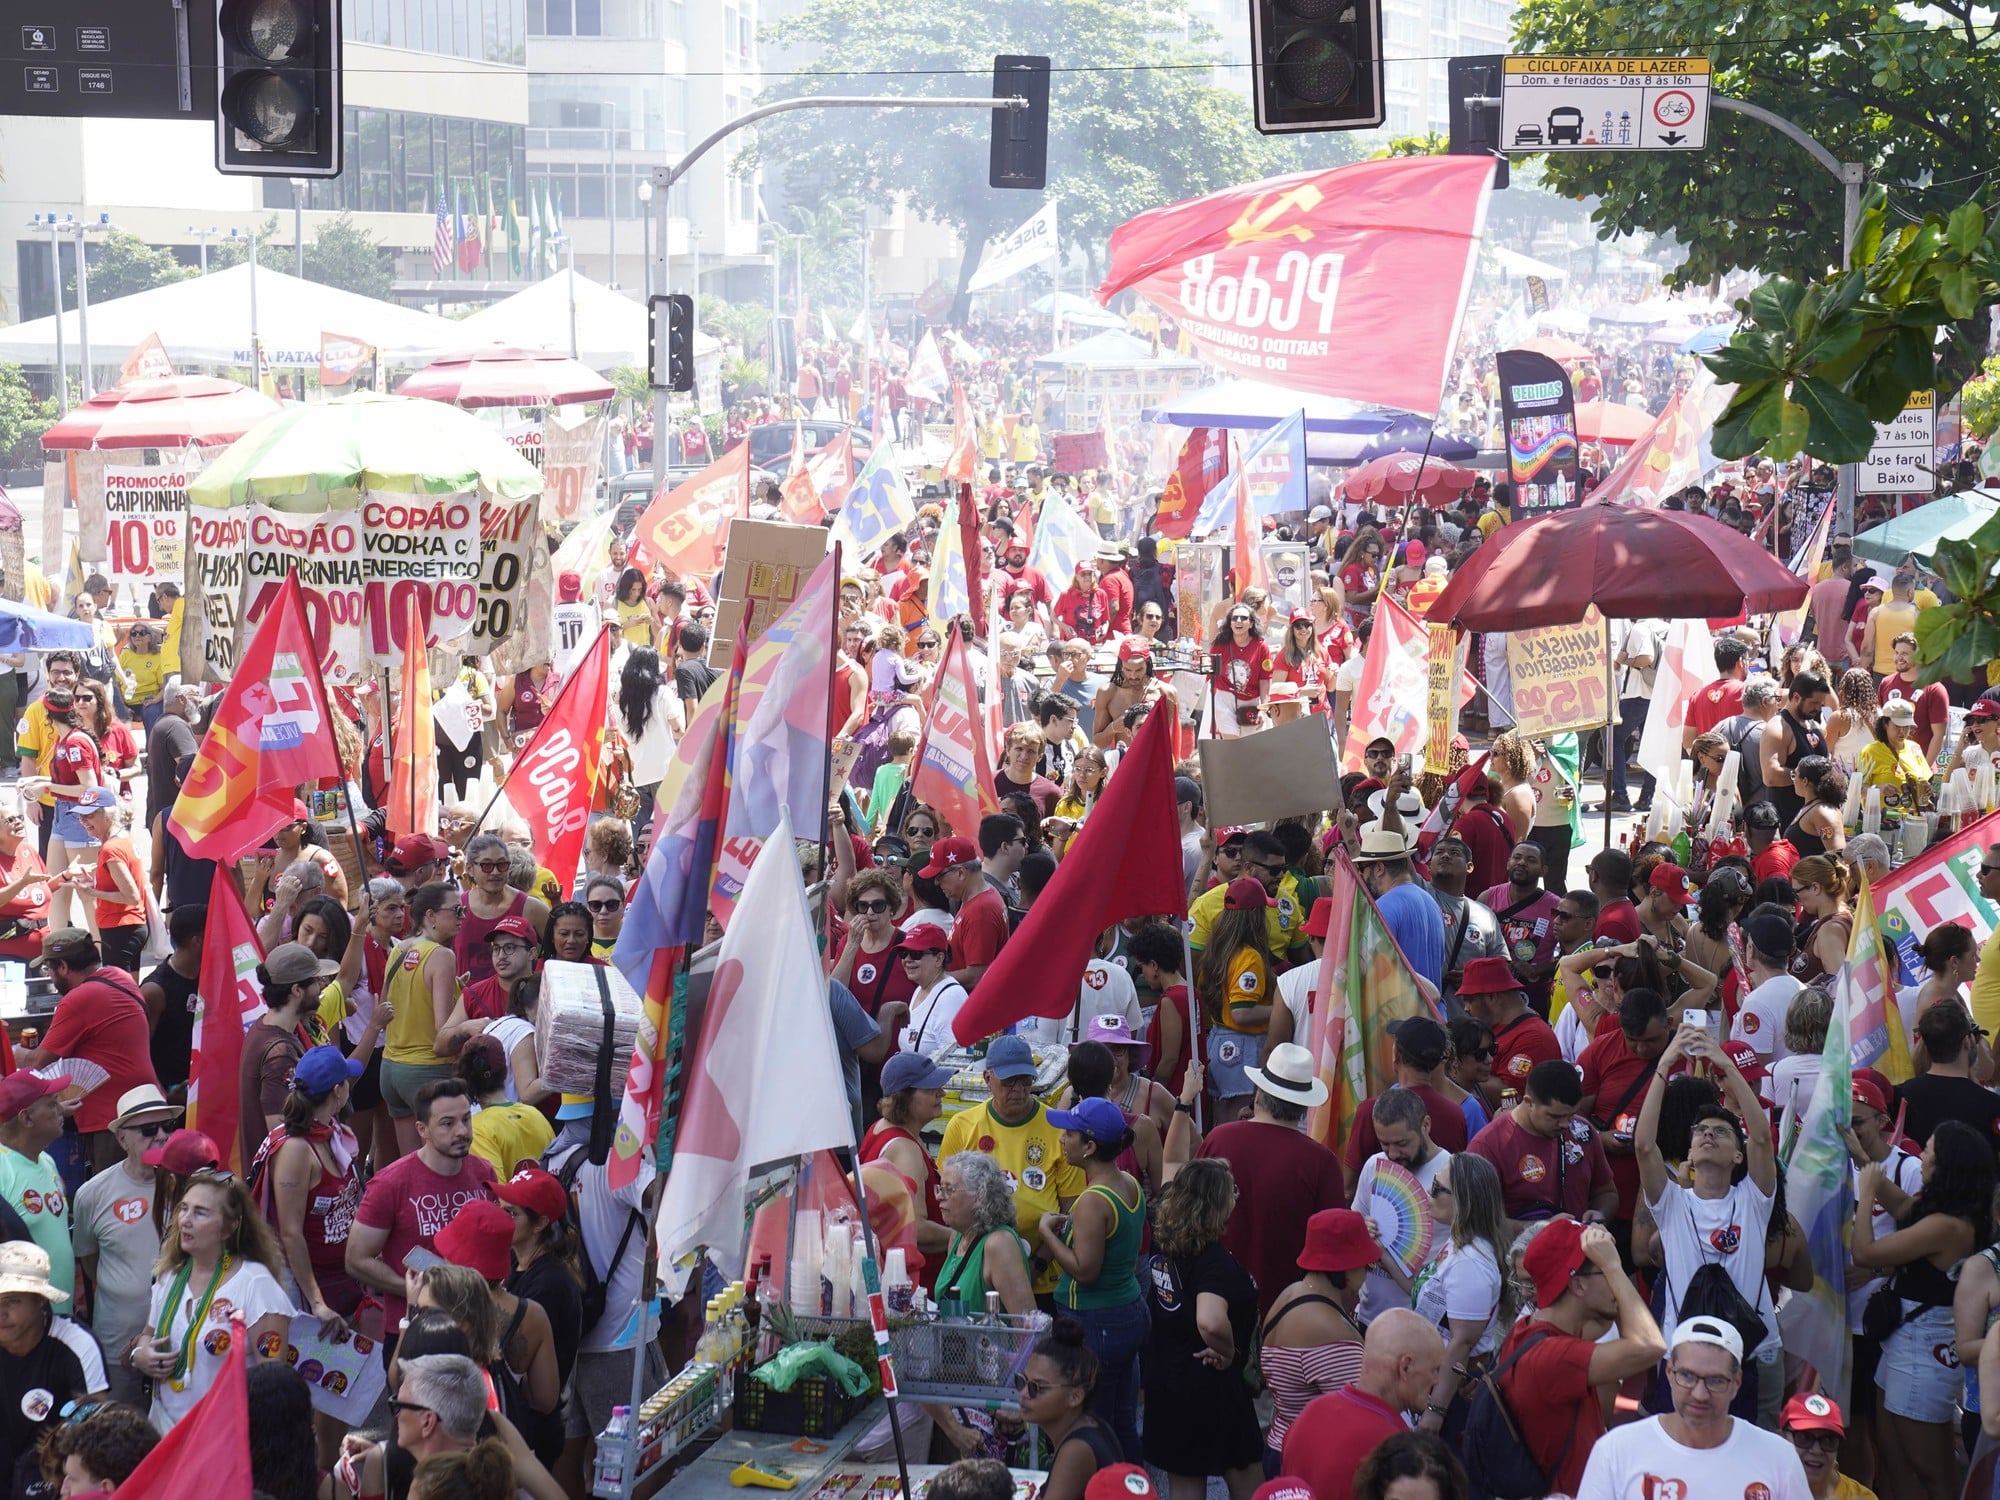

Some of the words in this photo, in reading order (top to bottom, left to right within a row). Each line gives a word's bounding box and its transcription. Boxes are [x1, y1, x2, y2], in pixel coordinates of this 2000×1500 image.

[1528, 60, 1614, 72] CICLOFAIXA
[1618, 61, 1635, 72] DE
[1640, 61, 1686, 73] LAZER
[1522, 76, 1549, 85] Dom.
[1564, 75, 1608, 85] feriados
[1620, 76, 1640, 85] Das
[1644, 76, 1650, 85] 8
[1656, 75, 1668, 85] às
[1672, 75, 1691, 85] 16h
[276, 351, 321, 363] PATAC
[1512, 381, 1563, 401] BEBIDAS
[1884, 431, 1891, 440] 7
[1894, 430, 1906, 440] às
[1910, 430, 1930, 440] 10h
[1866, 454, 1892, 466] Use
[1896, 454, 1926, 465] farol
[106, 473, 186, 490] PROMOÇÃO
[1878, 472, 1915, 484] Baixo
[106, 490, 187, 512] CAIPIRINHA
[363, 501, 470, 530] COPÃO
[252, 515, 355, 555] COPÃO
[364, 532, 448, 556] VODKA
[155, 562, 180, 570] BRINDE
[248, 551, 363, 586] CAIPIRINHA
[362, 558, 481, 580] ENERGÉTICO
[558, 620, 583, 650] 10
[1897, 935, 1919, 969] VICE
[1089, 971, 1104, 988] 13
[1733, 1049, 1754, 1061] Lula
[120, 1200, 144, 1221] 13
[409, 1193, 449, 1211] YOU
[420, 1208, 449, 1225] LIVE
